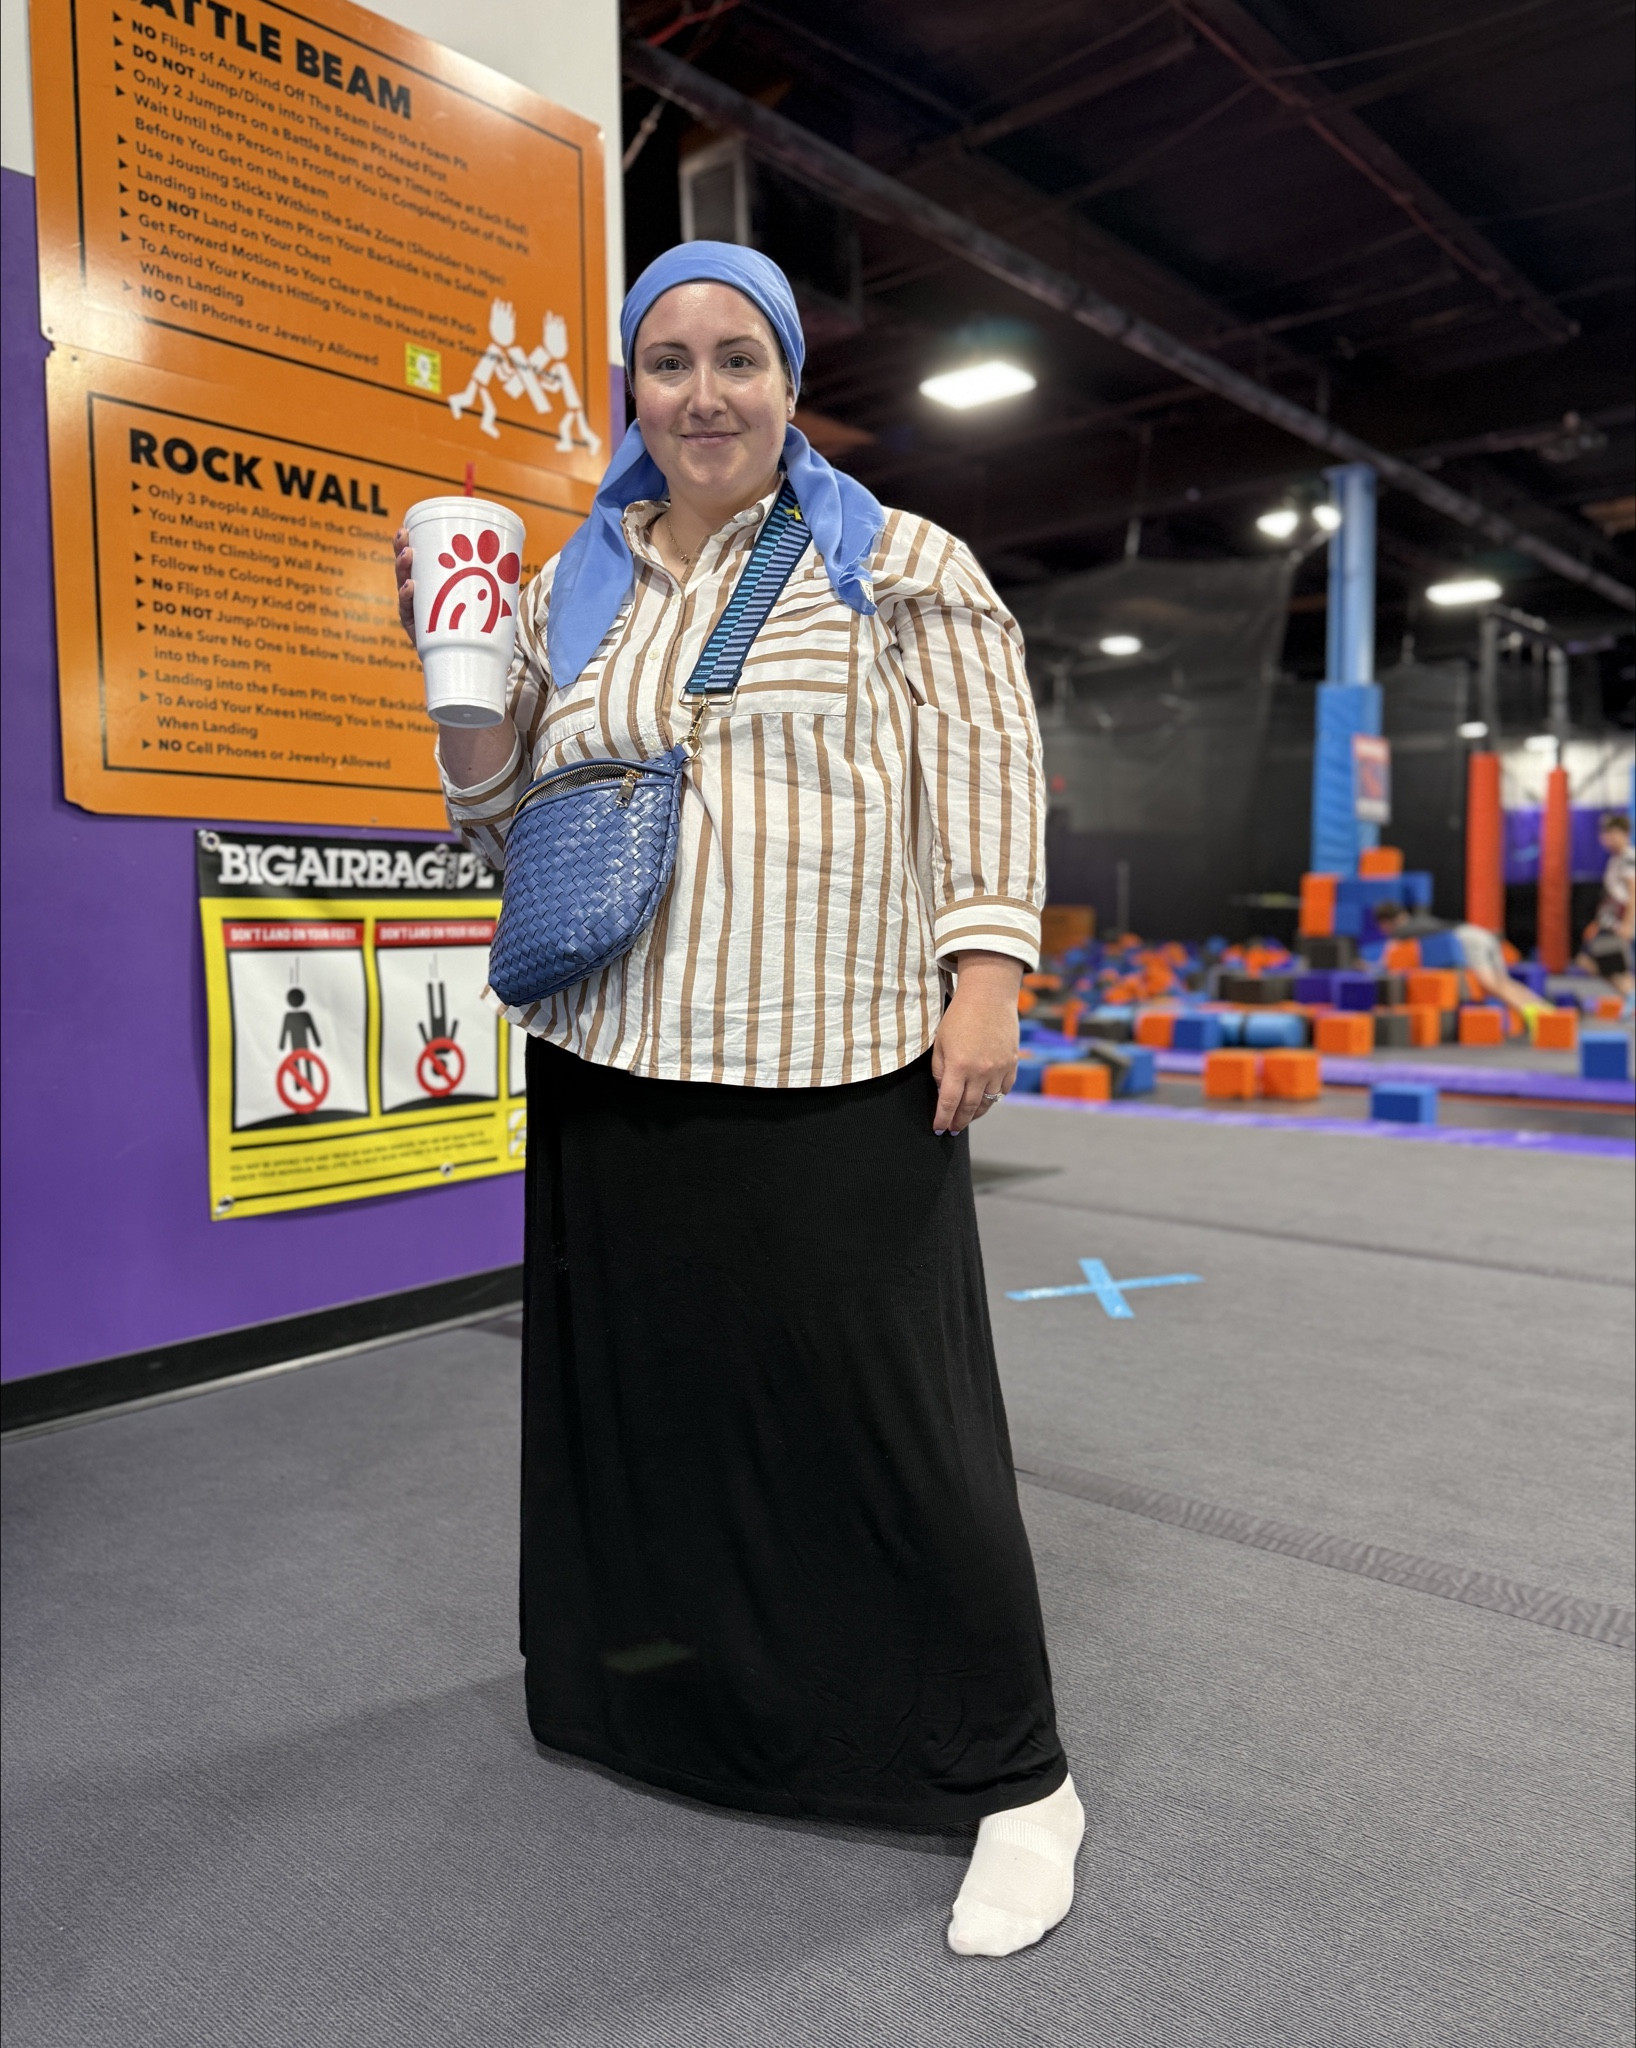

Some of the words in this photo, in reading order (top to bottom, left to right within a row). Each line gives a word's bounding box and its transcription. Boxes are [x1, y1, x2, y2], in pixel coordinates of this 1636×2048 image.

[132, 20, 156, 39] NO
[161, 32, 195, 57] Flips
[200, 52, 214, 64] of
[218, 57, 245, 80] Any
[249, 69, 280, 92] Kind
[284, 84, 305, 101] Off
[140, 0, 282, 64] TTLE
[296, 38, 412, 120] BEAM
[133, 44, 157, 63] DO
[162, 57, 195, 78] NOT
[198, 72, 275, 112] Jump/Dive
[279, 103, 304, 124] into
[133, 69, 169, 95] Only
[174, 84, 182, 98] 2
[186, 91, 247, 124] Jumpers
[283, 128, 320, 152] Battle
[134, 92, 168, 116] Wait
[172, 107, 206, 131] Until
[210, 123, 233, 141] the
[237, 133, 282, 159] Person
[135, 117, 184, 145] Before
[188, 136, 214, 157] You
[218, 149, 243, 168] Get
[267, 168, 289, 184] the
[136, 141, 163, 161] Use
[168, 153, 229, 188] Jousting
[233, 177, 272, 201] Sticks
[275, 192, 318, 217] Within
[137, 165, 196, 200] Landing
[200, 187, 228, 207] into
[231, 200, 253, 217] the
[257, 208, 293, 230] Foam
[138, 189, 162, 207] DO
[167, 199, 199, 219] NOT
[204, 212, 237, 233] Land
[262, 231, 292, 251] Your
[138, 214, 165, 233] Get
[169, 223, 228, 253] Forward
[232, 244, 280, 270] Motion
[139, 236, 156, 253] To
[160, 244, 203, 268] Avoid
[206, 258, 238, 279] Your
[241, 270, 283, 294] Knees
[286, 285, 330, 312] Hitting
[140, 261, 183, 285] When
[188, 276, 244, 307] Landing
[142, 285, 166, 303] NO
[170, 294, 198, 313] Cell
[202, 303, 252, 329] Phones
[256, 323, 270, 333] or
[274, 326, 324, 353] Jewelry
[129, 427, 263, 491] ROCK
[273, 459, 389, 518] WALL
[148, 484, 183, 505] Only
[188, 492, 196, 505] 3
[200, 494, 248, 515] People
[251, 506, 306, 527] Allowed
[149, 507, 176, 524] You
[180, 514, 215, 531] Must
[219, 521, 250, 537] Wait
[253, 528, 285, 544] Until
[288, 536, 308, 549] the
[150, 531, 188, 548] Enter
[192, 539, 215, 554] the
[218, 543, 280, 569] Climbing
[283, 556, 312, 570] Wall
[151, 554, 199, 573] Follow
[203, 563, 225, 578] the
[229, 567, 282, 587] Colored
[286, 577, 316, 595] Pegs
[152, 578, 173, 591] No
[177, 581, 210, 599] Flips
[214, 588, 228, 600] of
[232, 591, 258, 608] Any
[262, 595, 293, 611] Kind
[153, 600, 176, 615] DO
[181, 605, 212, 620] NOT
[216, 611, 290, 632] Jump/Dive
[154, 623, 193, 640] Make
[197, 629, 228, 645] Sure
[232, 635, 251, 648] No
[255, 638, 283, 653] One
[155, 646, 183, 662] into
[186, 651, 209, 665] the
[213, 654, 250, 670] Foam
[254, 659, 271, 673] Pit
[155, 669, 213, 691] Landing
[217, 677, 243, 691] into
[247, 681, 268, 694] the
[272, 683, 307, 698] Foam
[156, 692, 173, 706] To
[176, 695, 218, 711] Avoid
[221, 700, 252, 714] Your
[255, 704, 296, 719] Knees
[157, 716, 199, 731] When
[203, 720, 258, 740] Landing
[159, 739, 182, 752] NO
[186, 741, 213, 754] Cell
[217, 743, 267, 759] Phones
[270, 751, 284, 760] or
[287, 750, 337, 768] Jewelry
[218, 843, 446, 889] BIGAIRBAG
